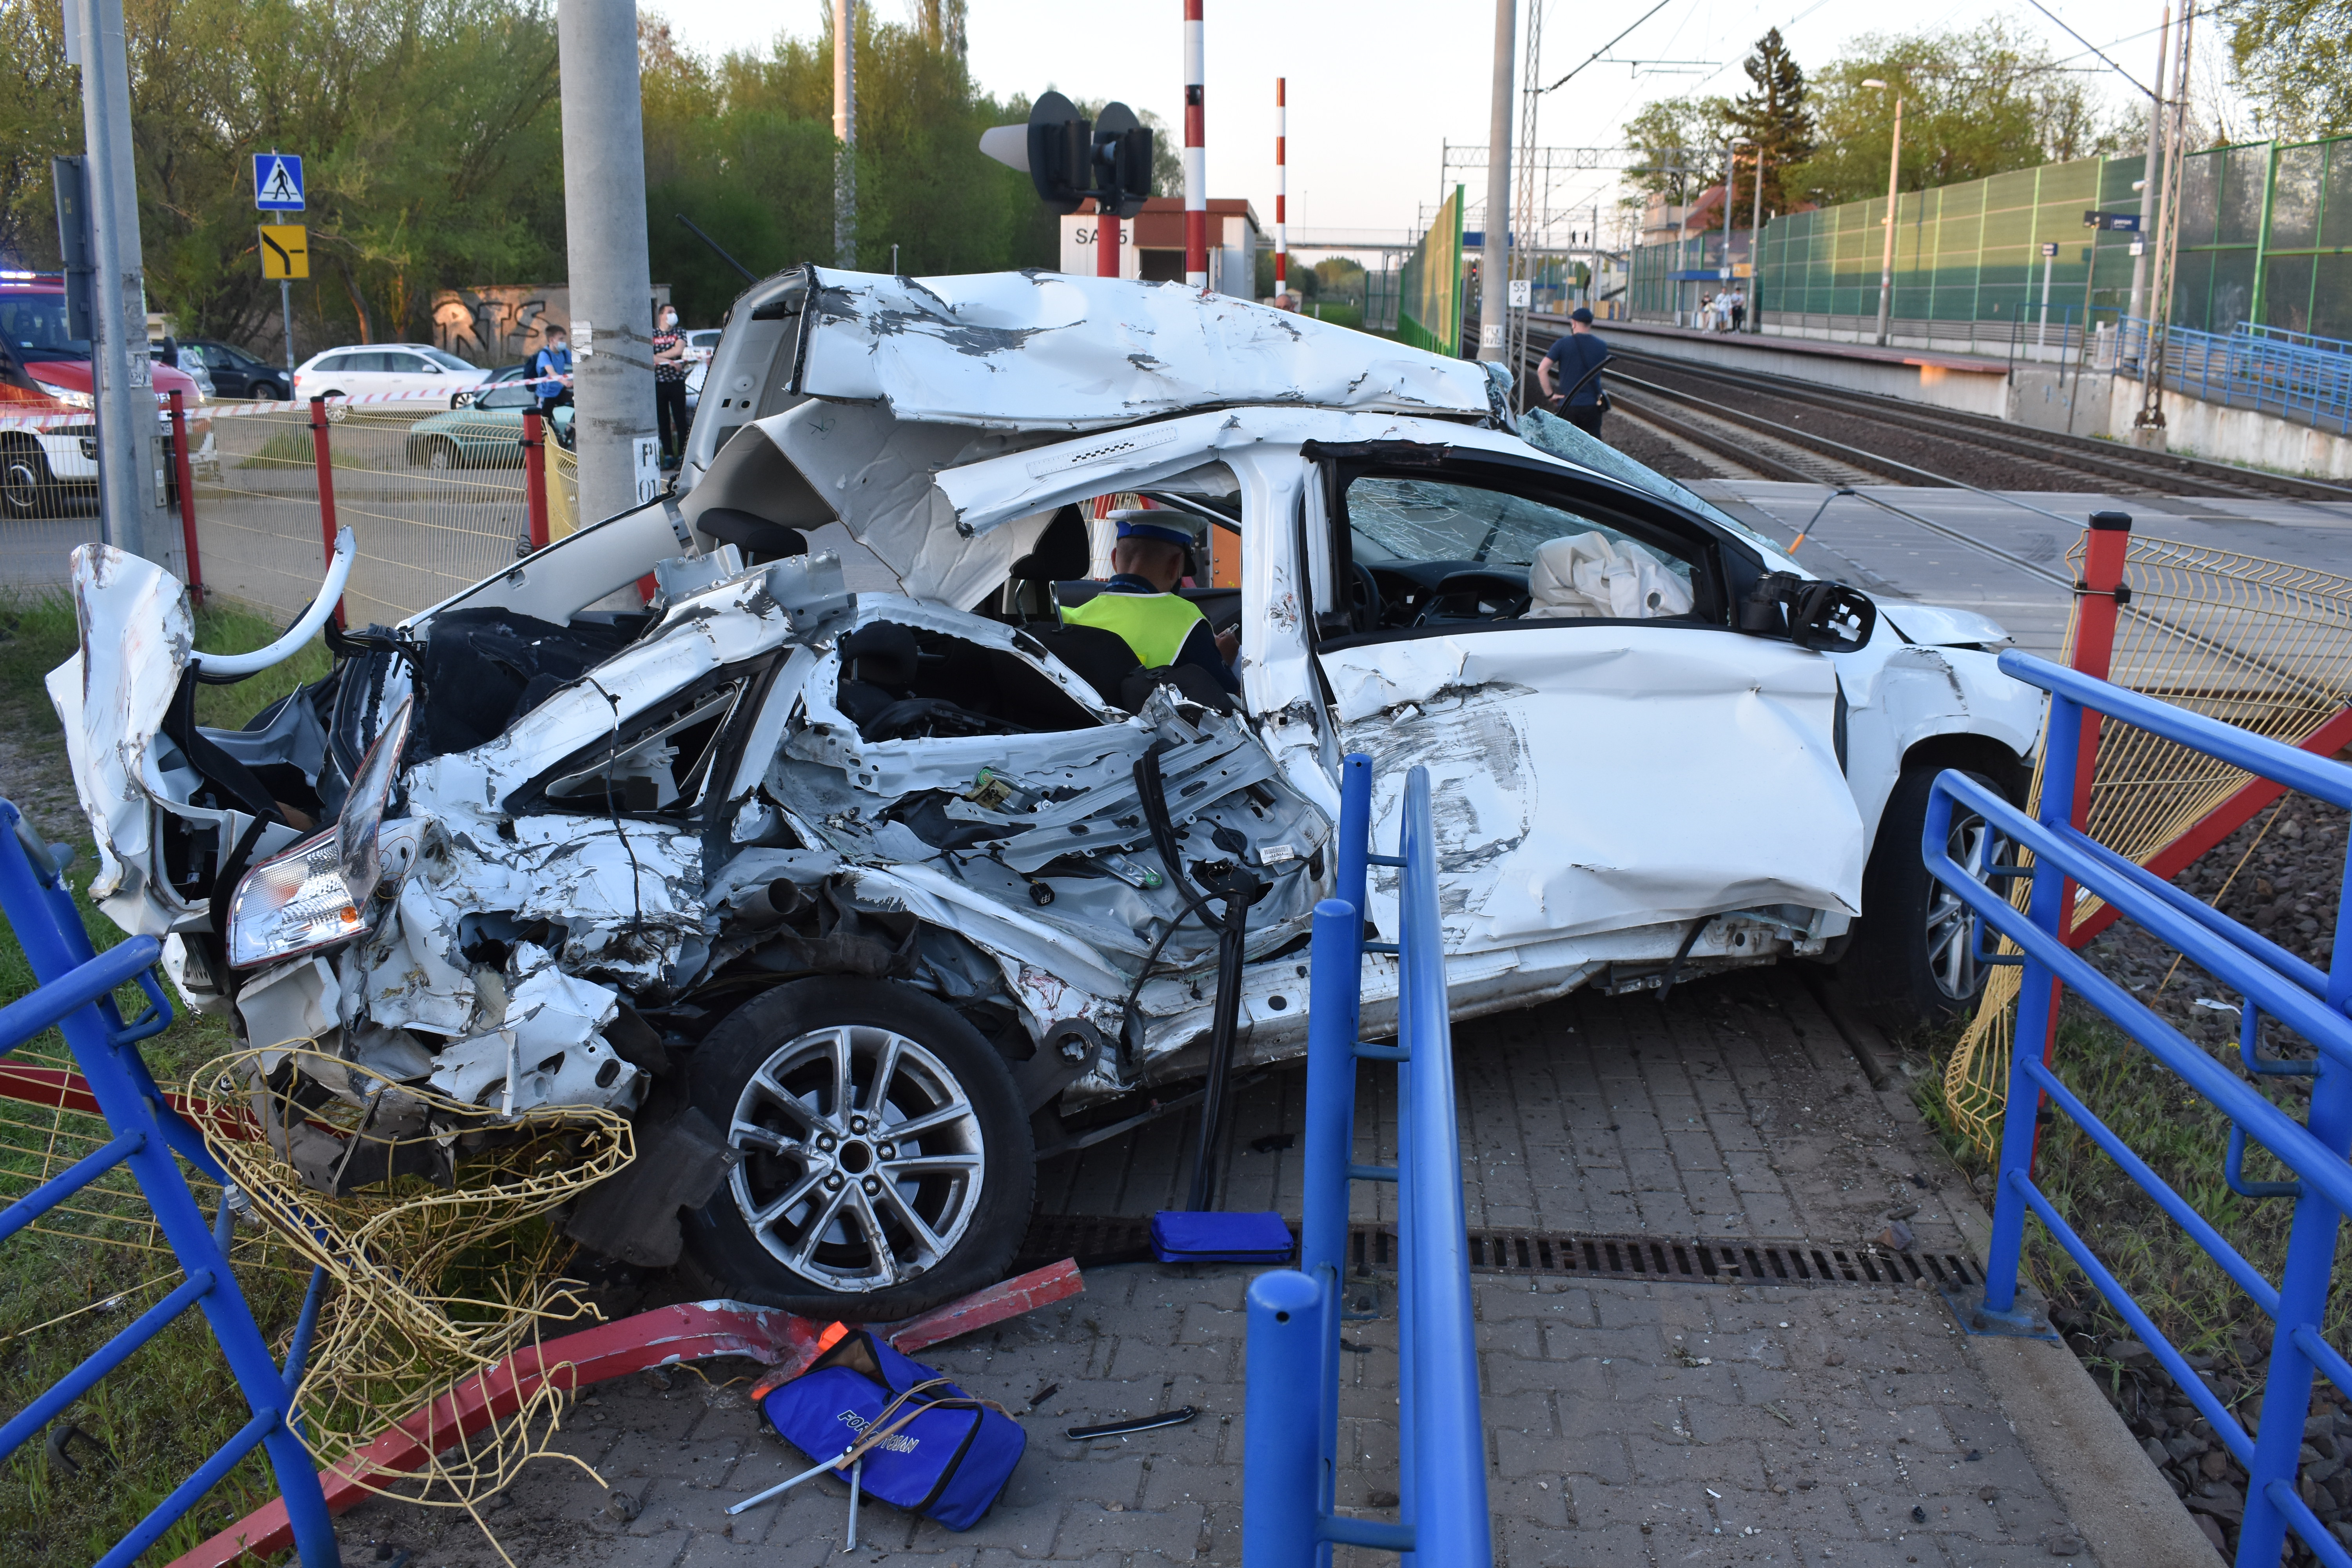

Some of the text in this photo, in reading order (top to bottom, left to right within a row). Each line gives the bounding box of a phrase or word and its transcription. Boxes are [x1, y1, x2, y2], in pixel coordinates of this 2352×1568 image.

[1514, 282, 1527, 292] 55
[1516, 295, 1523, 304] 4
[837, 1409, 920, 1454] FORTOSAN
